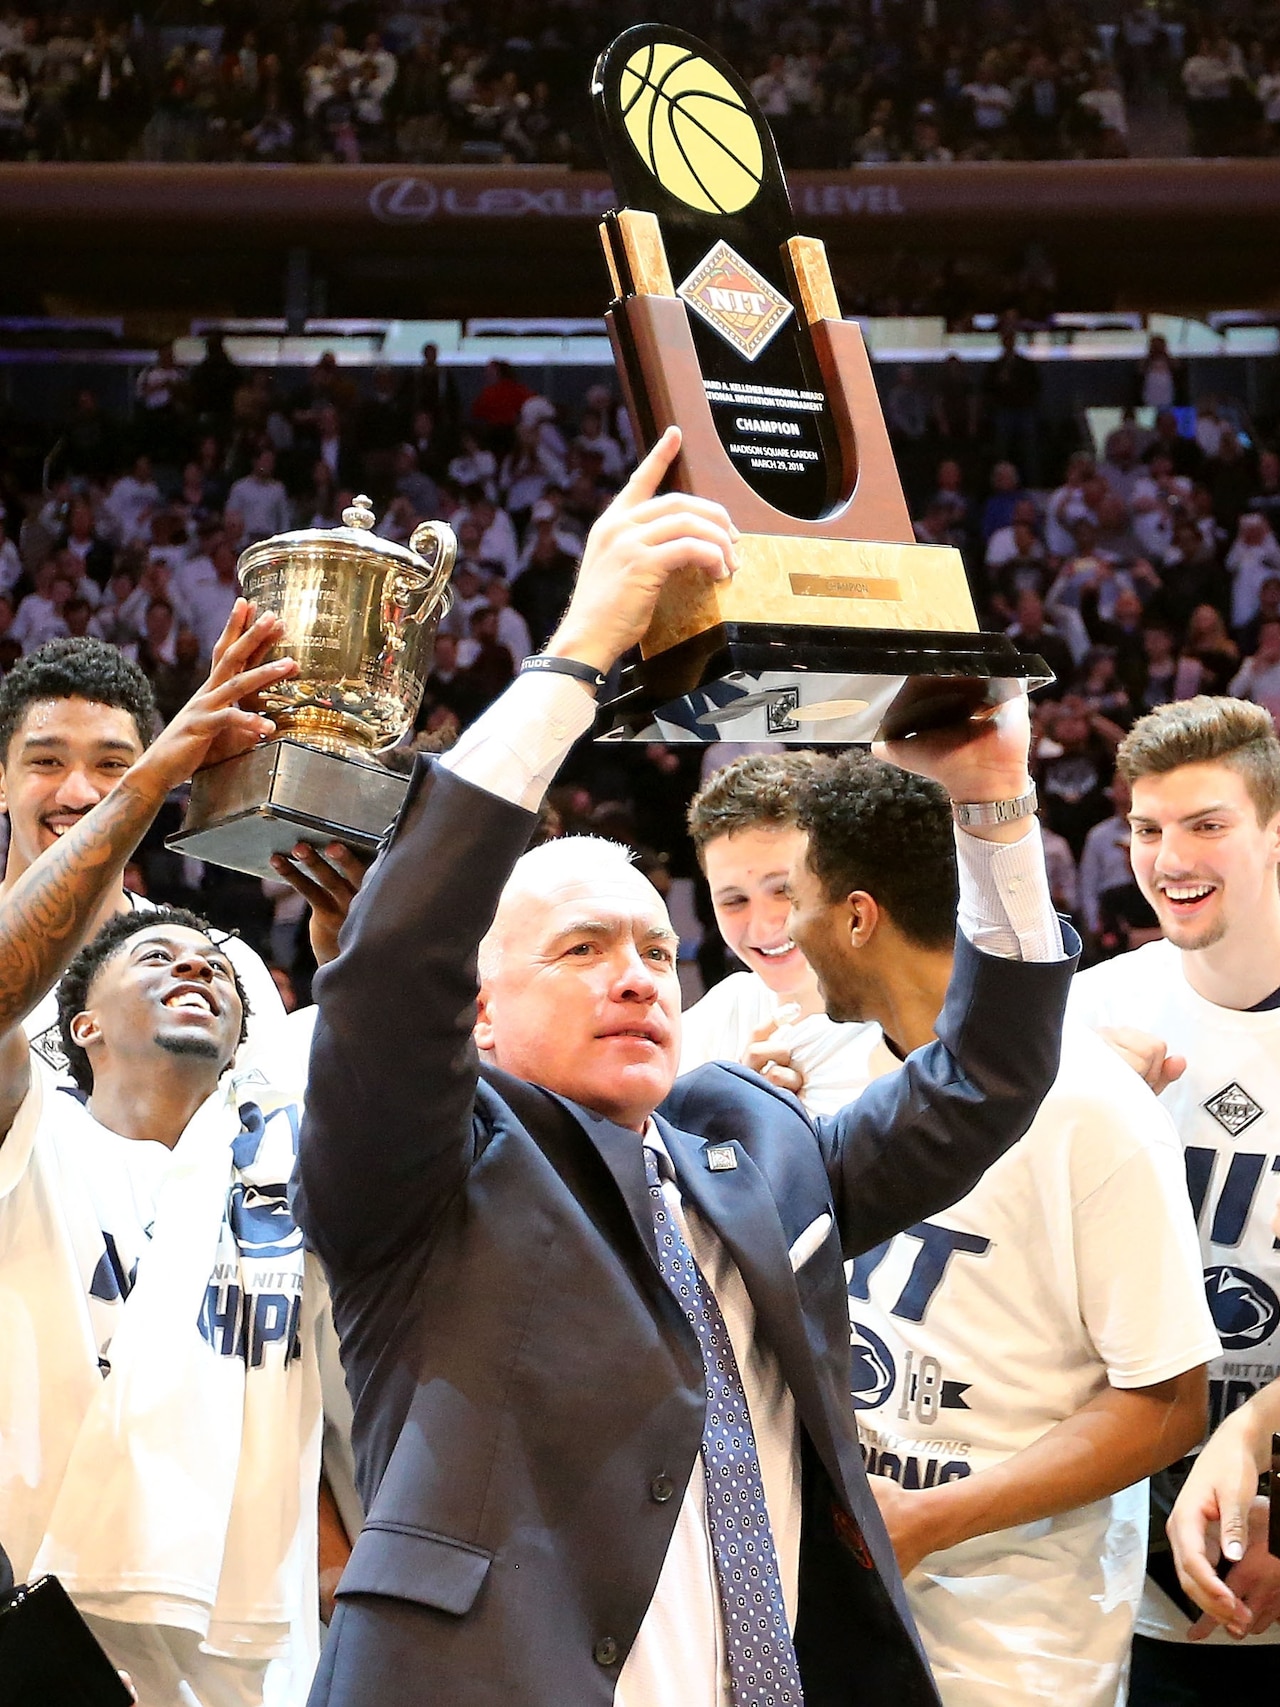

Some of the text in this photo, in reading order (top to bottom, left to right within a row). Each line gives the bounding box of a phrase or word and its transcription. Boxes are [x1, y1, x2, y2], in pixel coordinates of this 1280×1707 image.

[804, 186, 903, 215] LEVEL
[687, 251, 723, 292] NATIONAL
[705, 286, 767, 317] NIT
[763, 308, 784, 331] YORK
[729, 382, 763, 394] KELLEHER
[763, 386, 800, 399] MEMORIAL
[800, 390, 825, 401] AWARD
[734, 394, 775, 406] INVITATION
[774, 398, 823, 412] TOURNAMENT
[735, 417, 801, 437] CHAMPION
[729, 444, 819, 461] MADISON SQUARE GARDEN
[750, 459, 805, 472] MARCH 29, 2018
[826, 581, 869, 593] CHAMPION
[897, 1349, 942, 1426] 18
